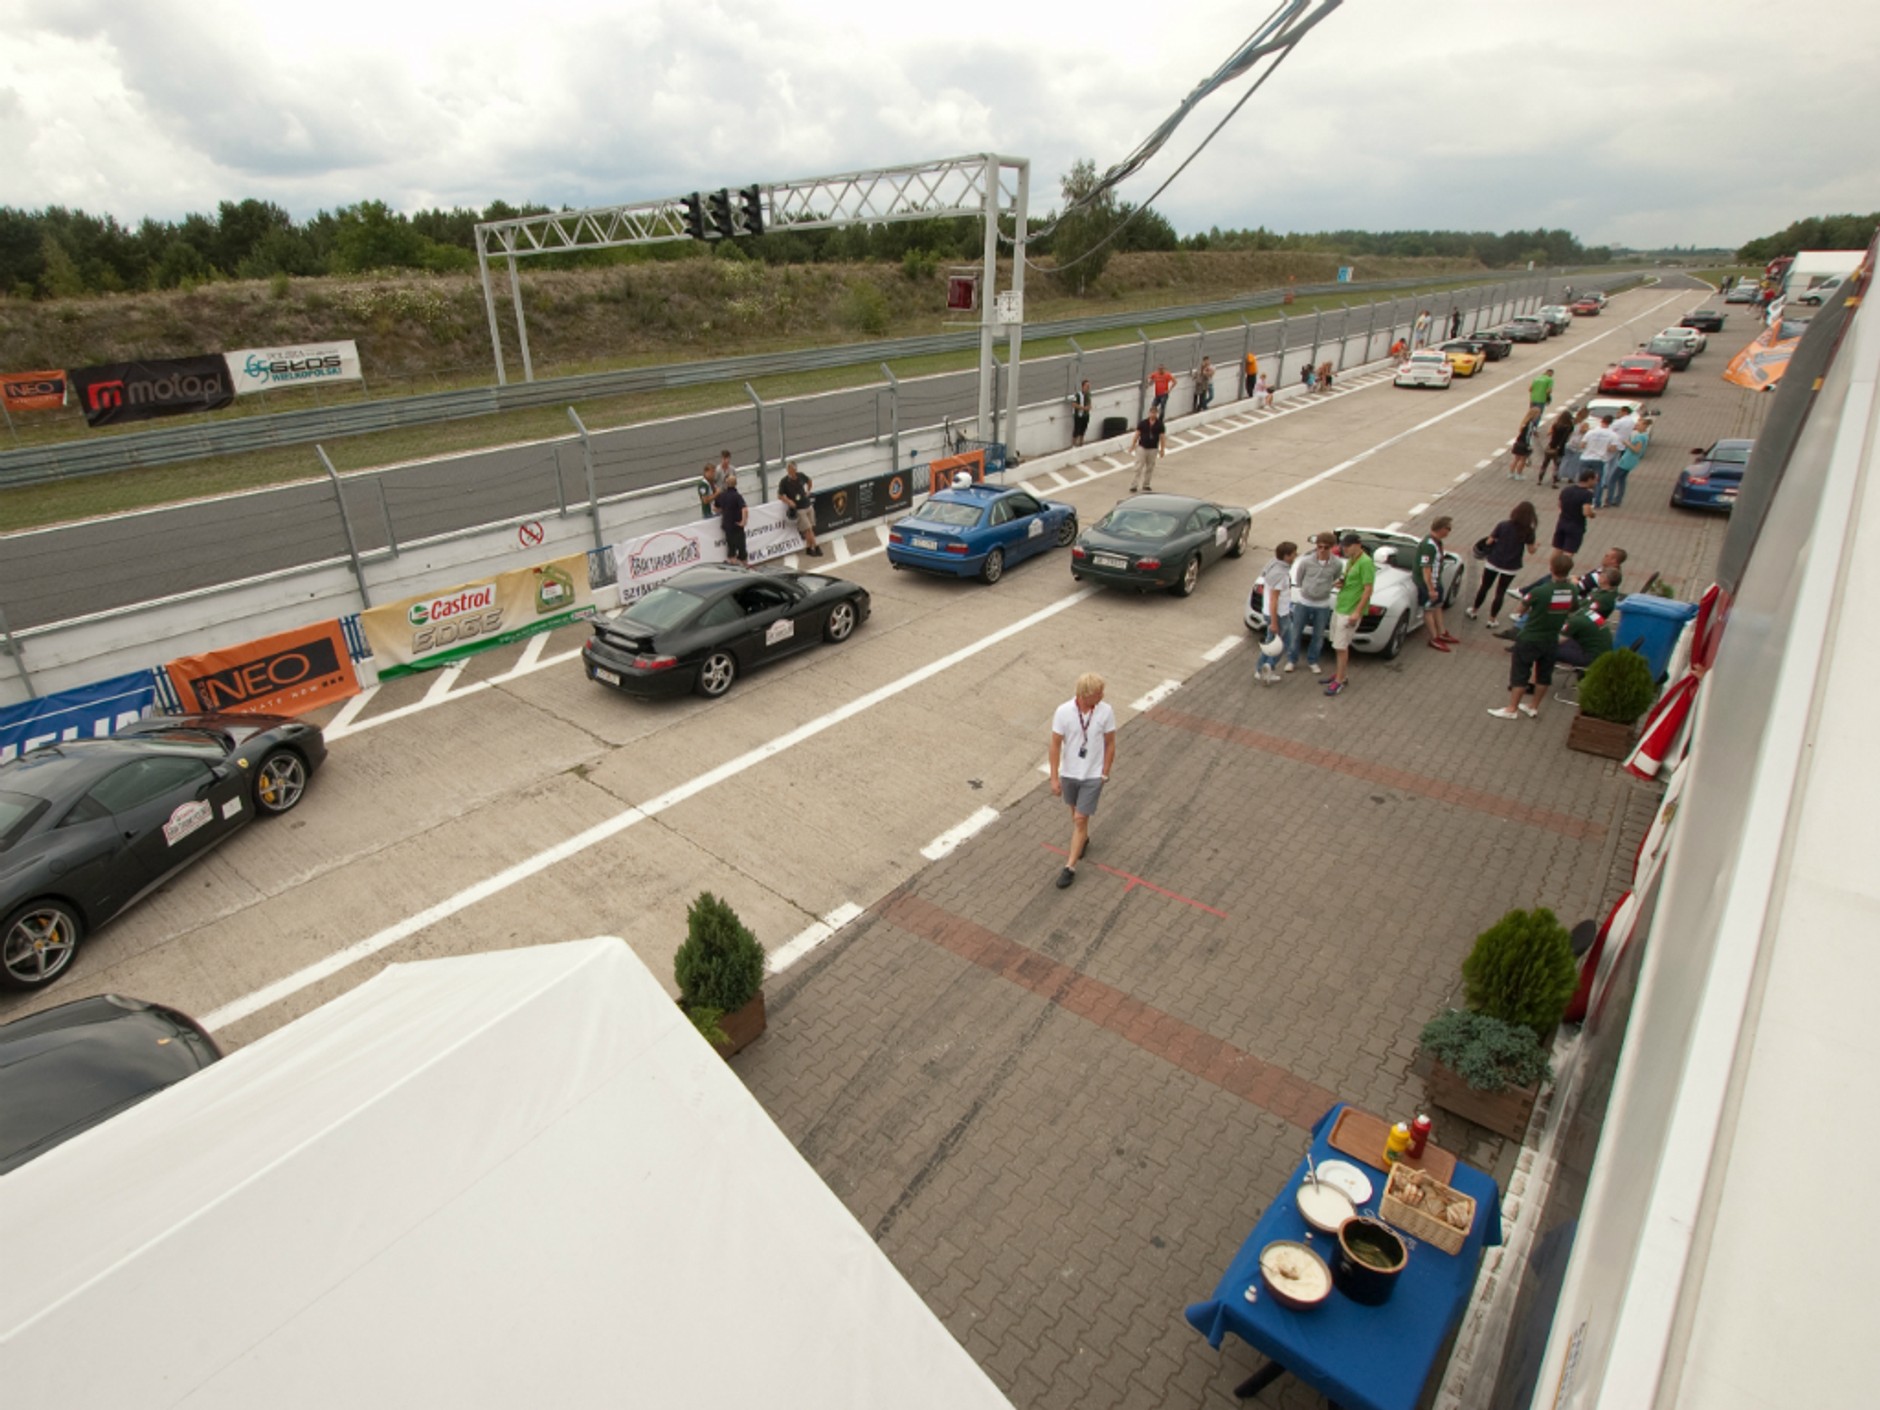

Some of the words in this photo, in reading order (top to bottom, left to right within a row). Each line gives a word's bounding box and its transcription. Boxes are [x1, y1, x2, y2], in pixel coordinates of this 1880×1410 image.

[10, 382, 54, 397] NEO
[128, 372, 223, 405] moto.pl
[271, 367, 342, 381] WIELKOPOLSKI
[431, 587, 491, 620] Castrol
[411, 607, 504, 655] EDGE
[206, 653, 310, 708] NEO
